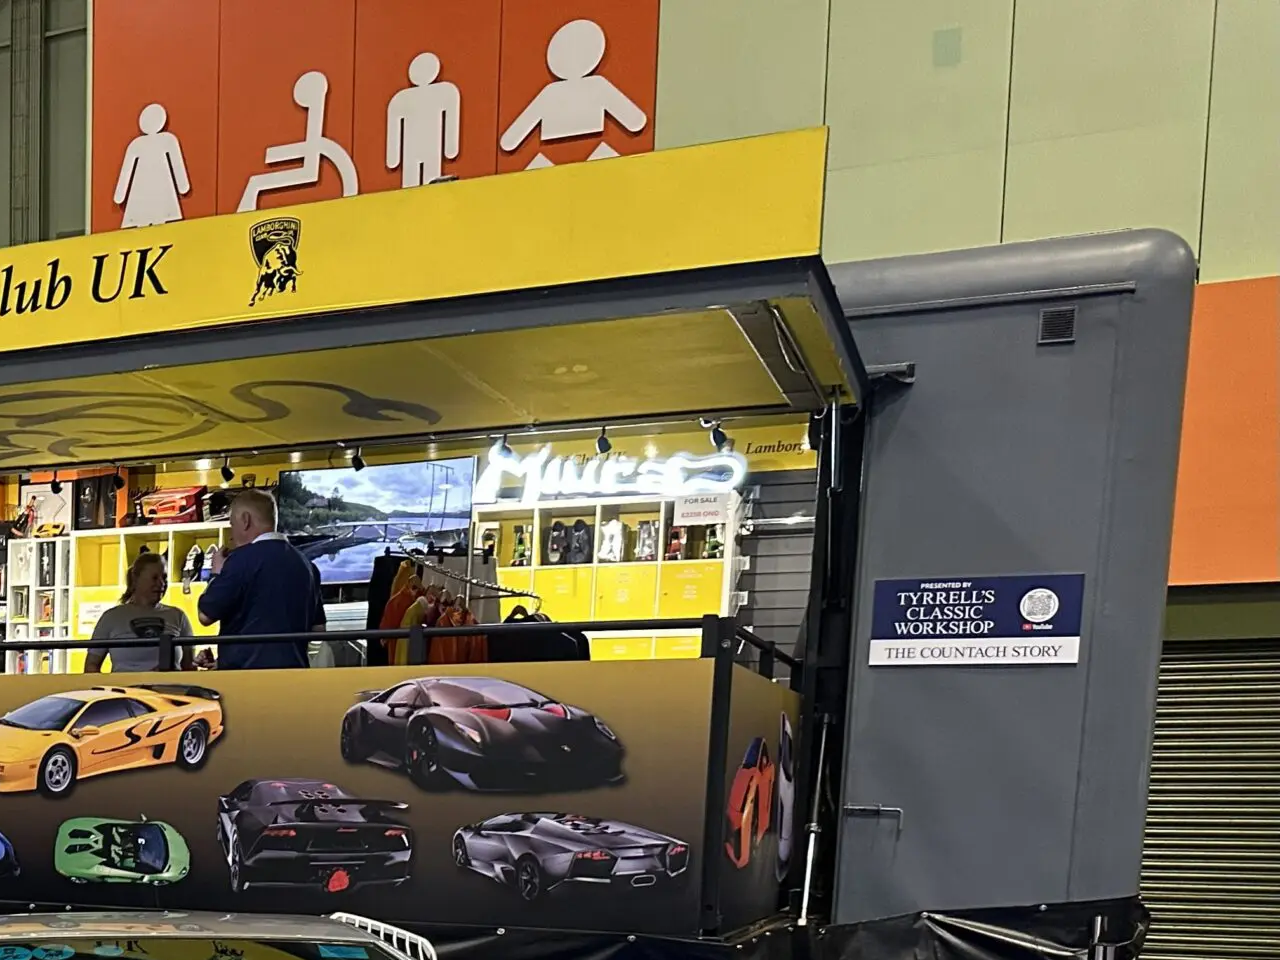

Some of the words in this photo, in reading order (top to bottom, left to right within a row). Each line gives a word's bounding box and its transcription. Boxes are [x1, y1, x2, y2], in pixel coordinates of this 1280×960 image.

[91, 243, 173, 303] UK
[897, 590, 995, 605] TYRRELL'S
[906, 605, 983, 620] CLASSIC
[894, 620, 995, 635] WORKSHOP
[884, 647, 916, 659] THE
[920, 645, 1007, 659] COUNTACH
[1011, 645, 1062, 658] STORY
